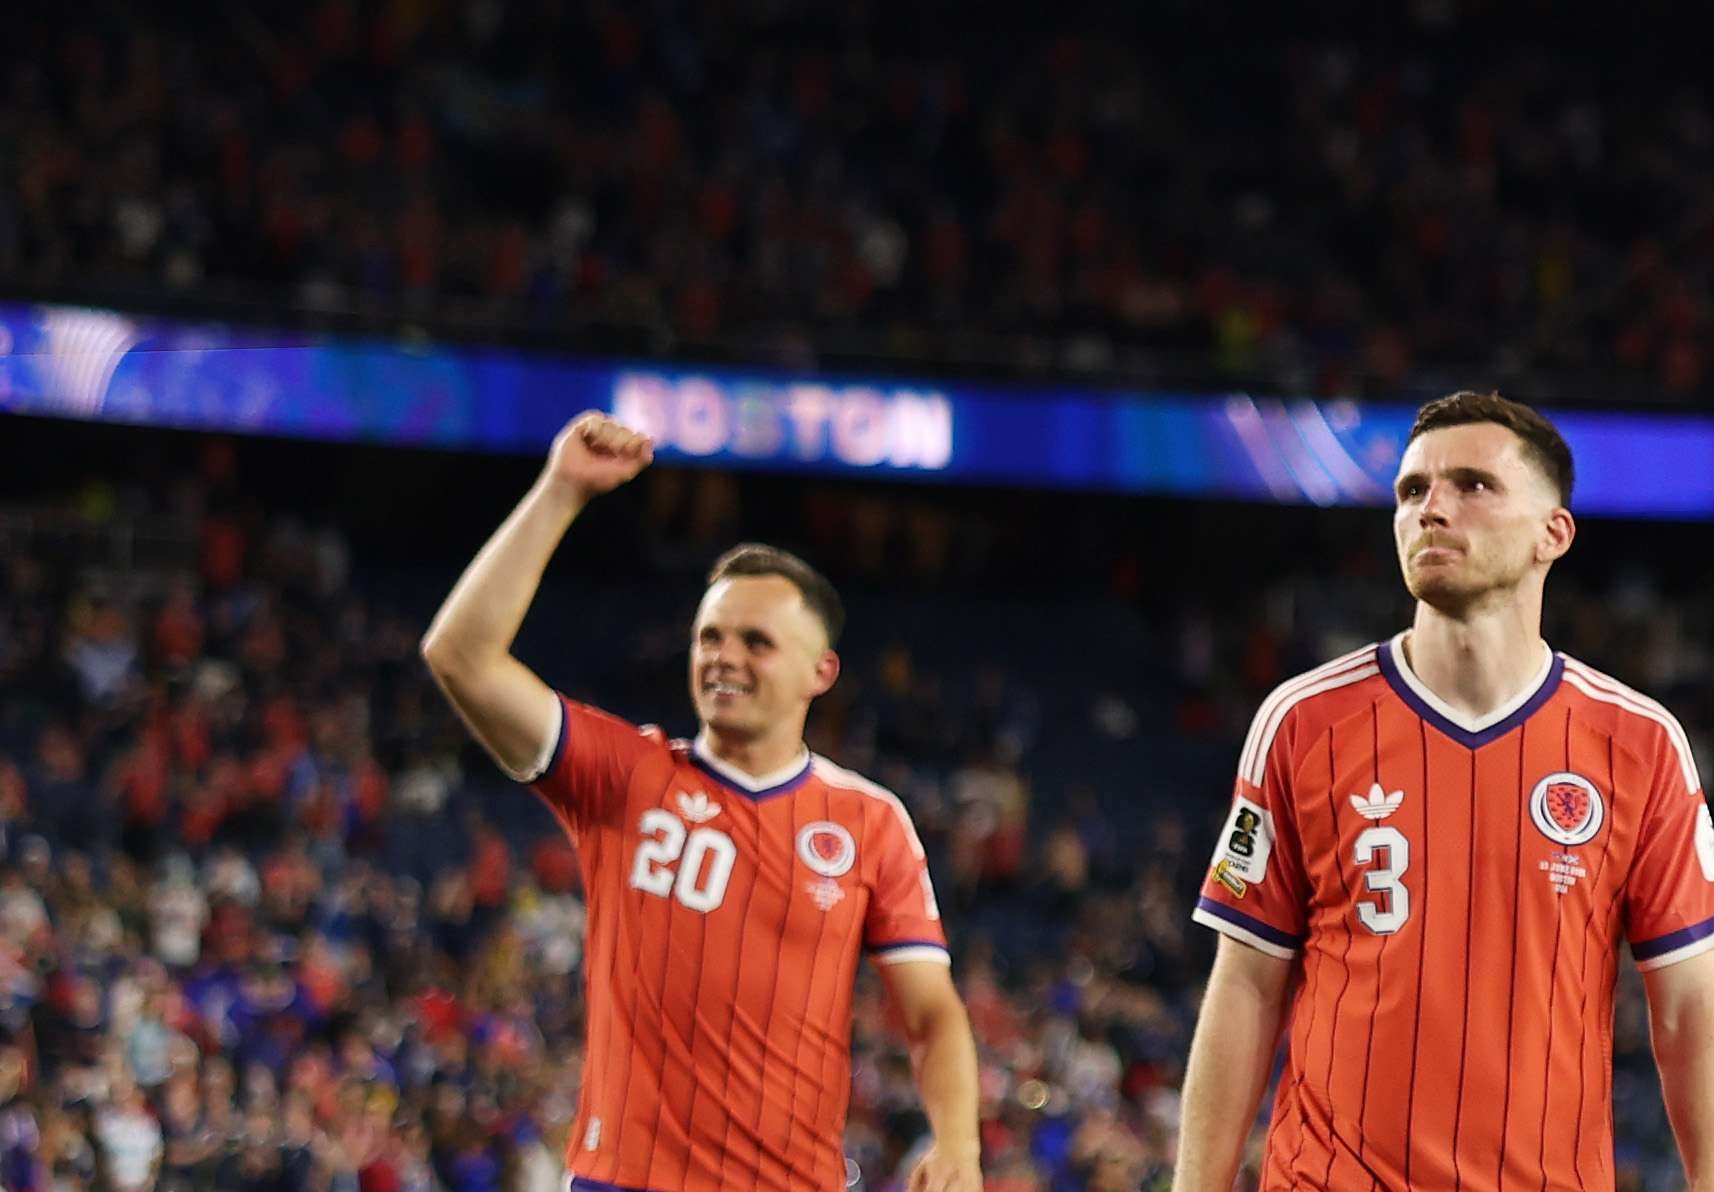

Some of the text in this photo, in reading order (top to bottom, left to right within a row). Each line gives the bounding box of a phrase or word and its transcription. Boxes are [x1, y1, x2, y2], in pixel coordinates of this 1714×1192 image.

[612, 372, 952, 469] BOSTON
[630, 808, 737, 913] 20
[1353, 826, 1410, 936] 3
